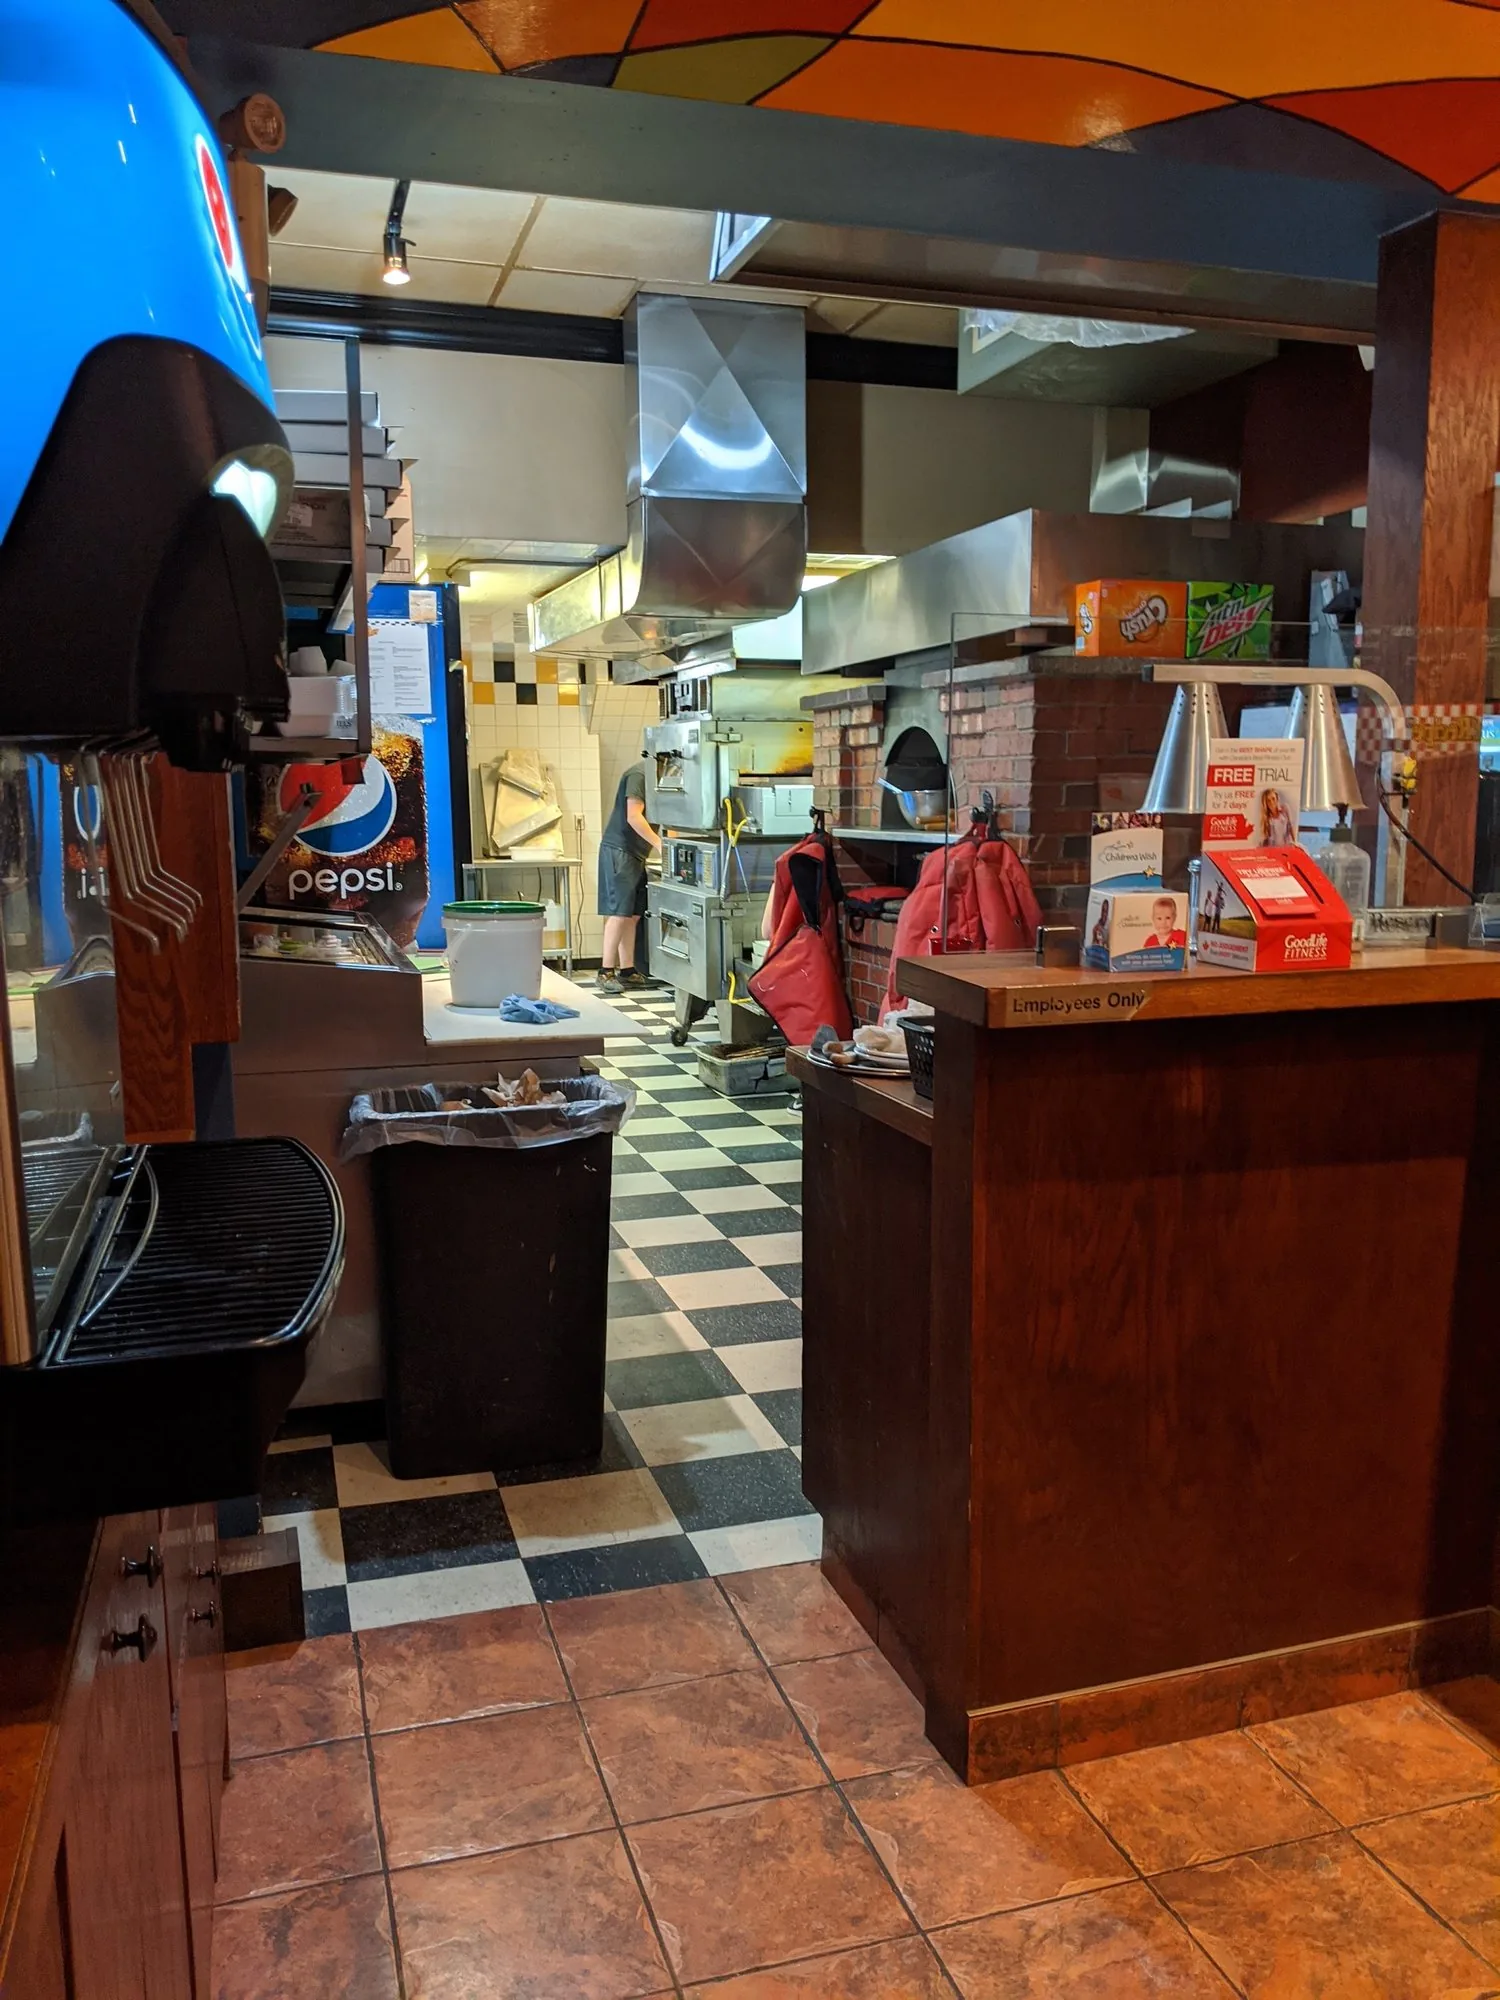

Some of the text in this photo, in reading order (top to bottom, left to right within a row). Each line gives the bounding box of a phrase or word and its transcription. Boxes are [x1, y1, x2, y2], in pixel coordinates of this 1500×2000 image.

[1121, 596, 1168, 641] Crush
[1213, 767, 1294, 783] FREE TRIAL
[1234, 790, 1256, 799] FREE
[1229, 801, 1248, 811] days
[1139, 852, 1157, 863] Wish
[288, 861, 394, 900] pepsi
[1284, 933, 1328, 948] GoodLife
[1284, 948, 1327, 959] FITNESS
[1013, 992, 1146, 1015] Employees Only
